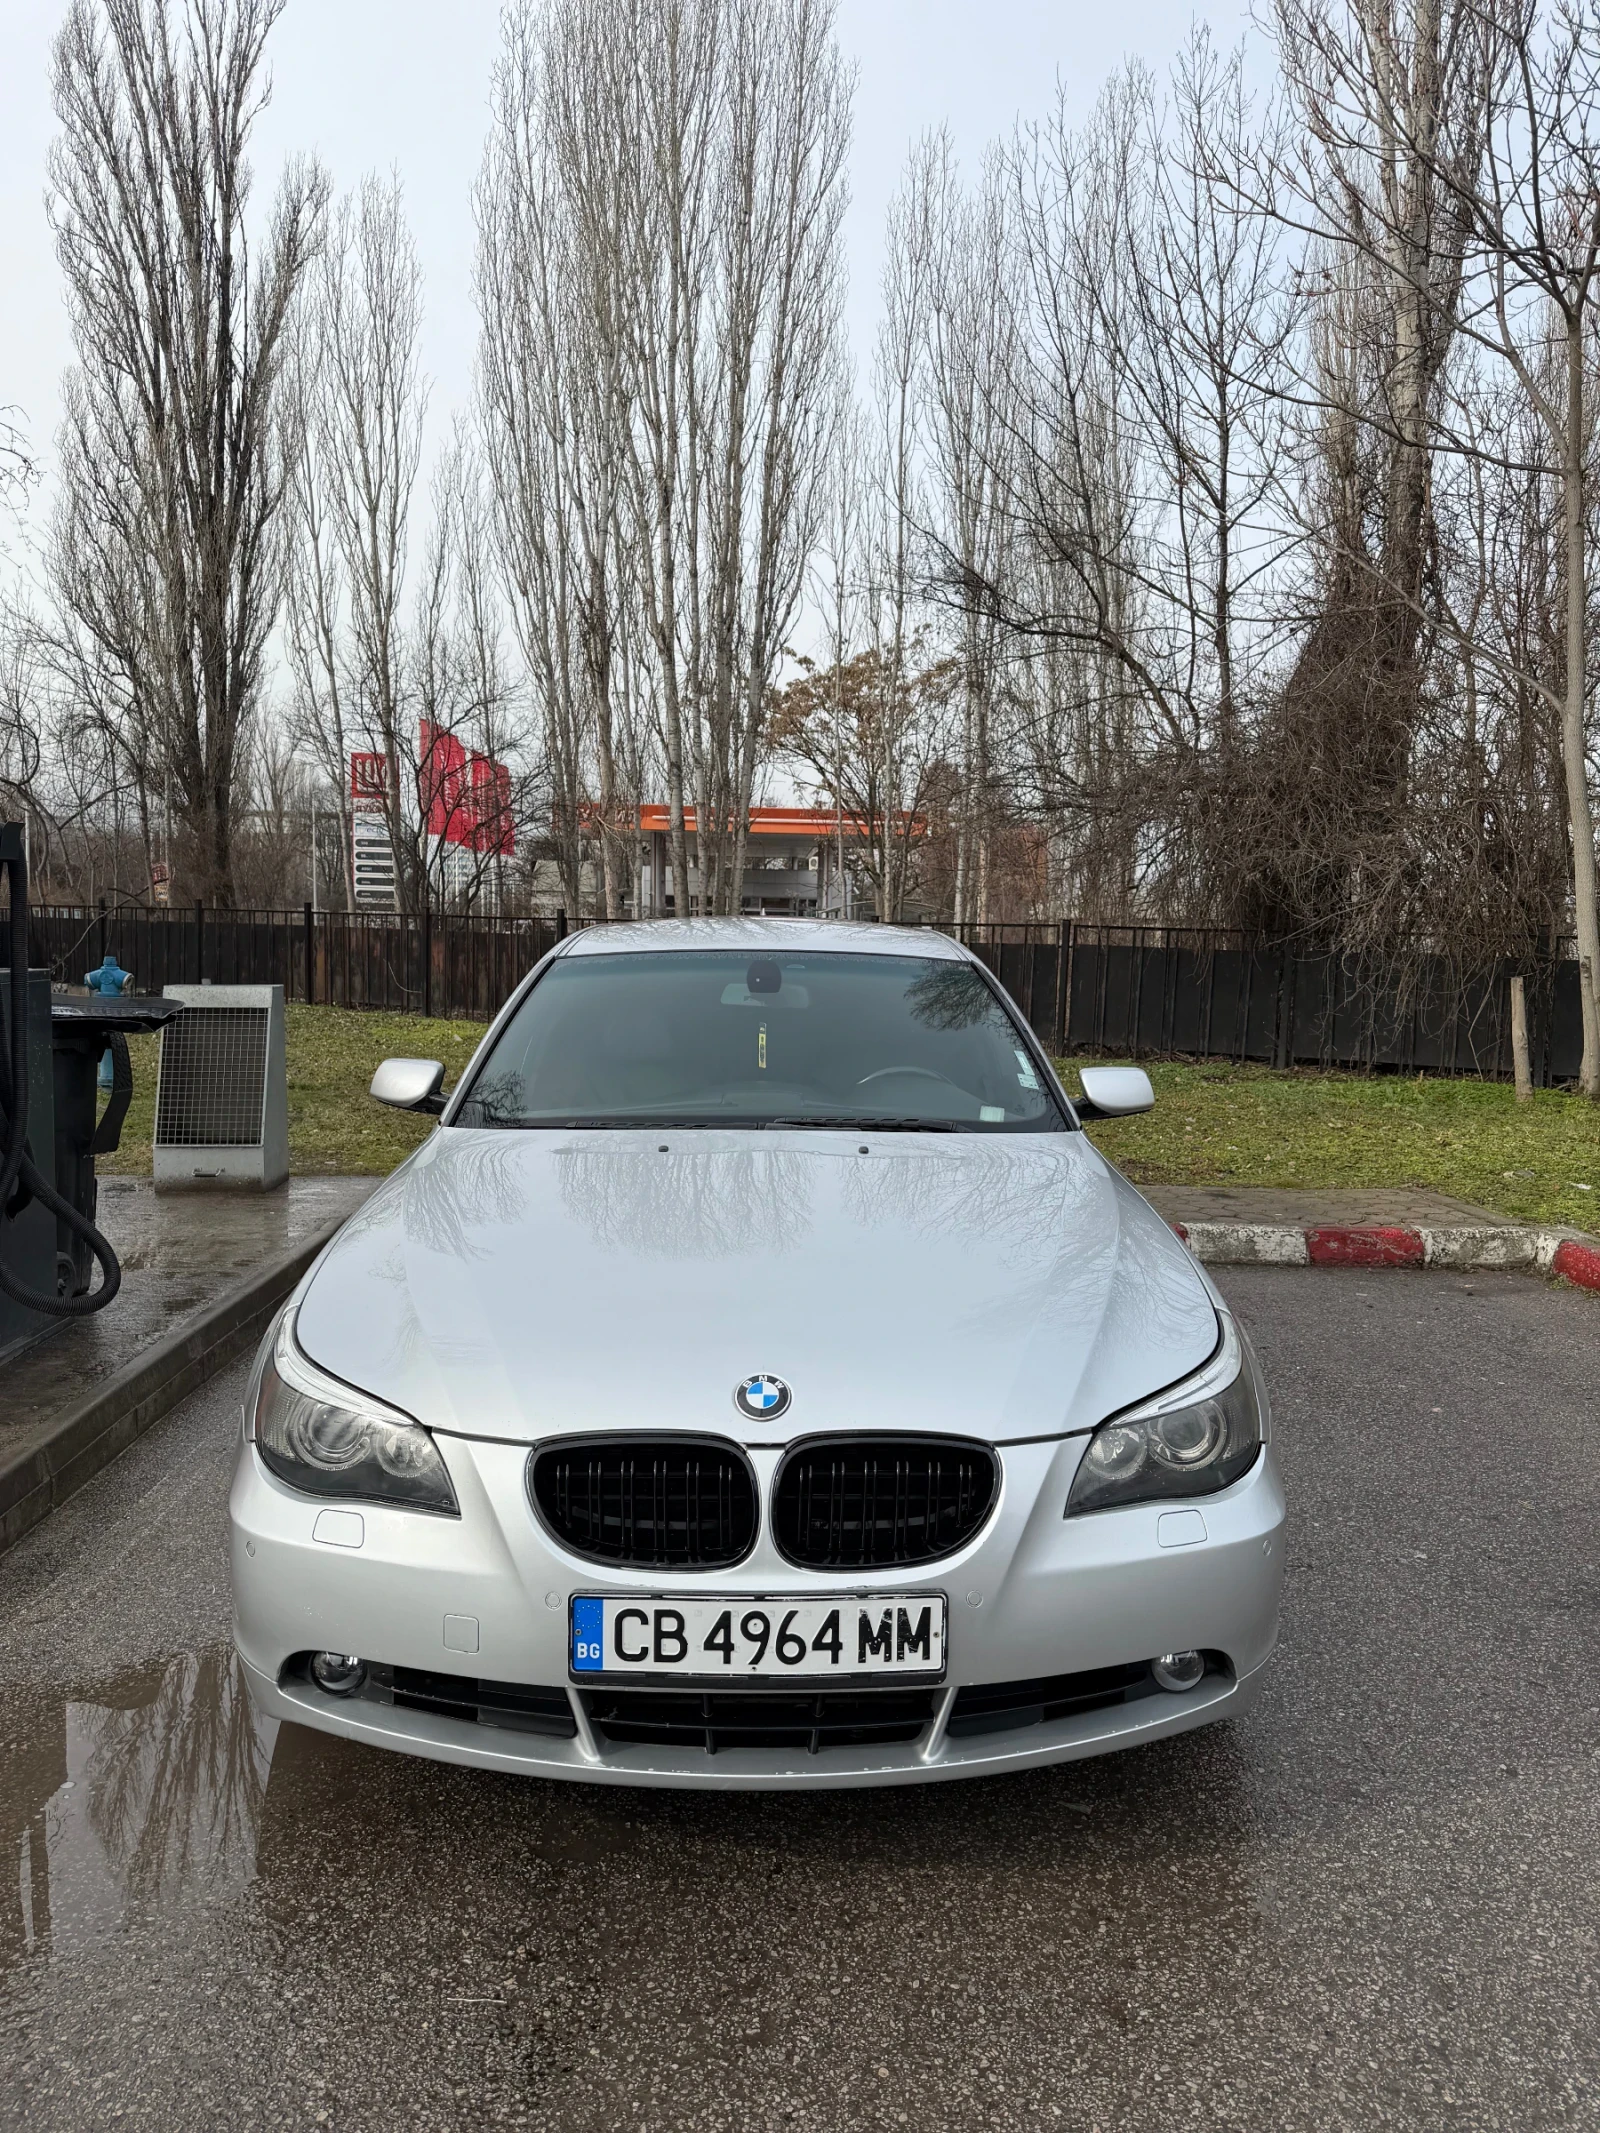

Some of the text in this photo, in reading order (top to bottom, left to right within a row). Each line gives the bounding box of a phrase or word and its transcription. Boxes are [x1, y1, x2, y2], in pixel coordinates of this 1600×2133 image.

[742, 1375, 785, 1389] BMW
[614, 1607, 932, 1665] CB 4964 MM
[577, 1642, 600, 1659] BG
